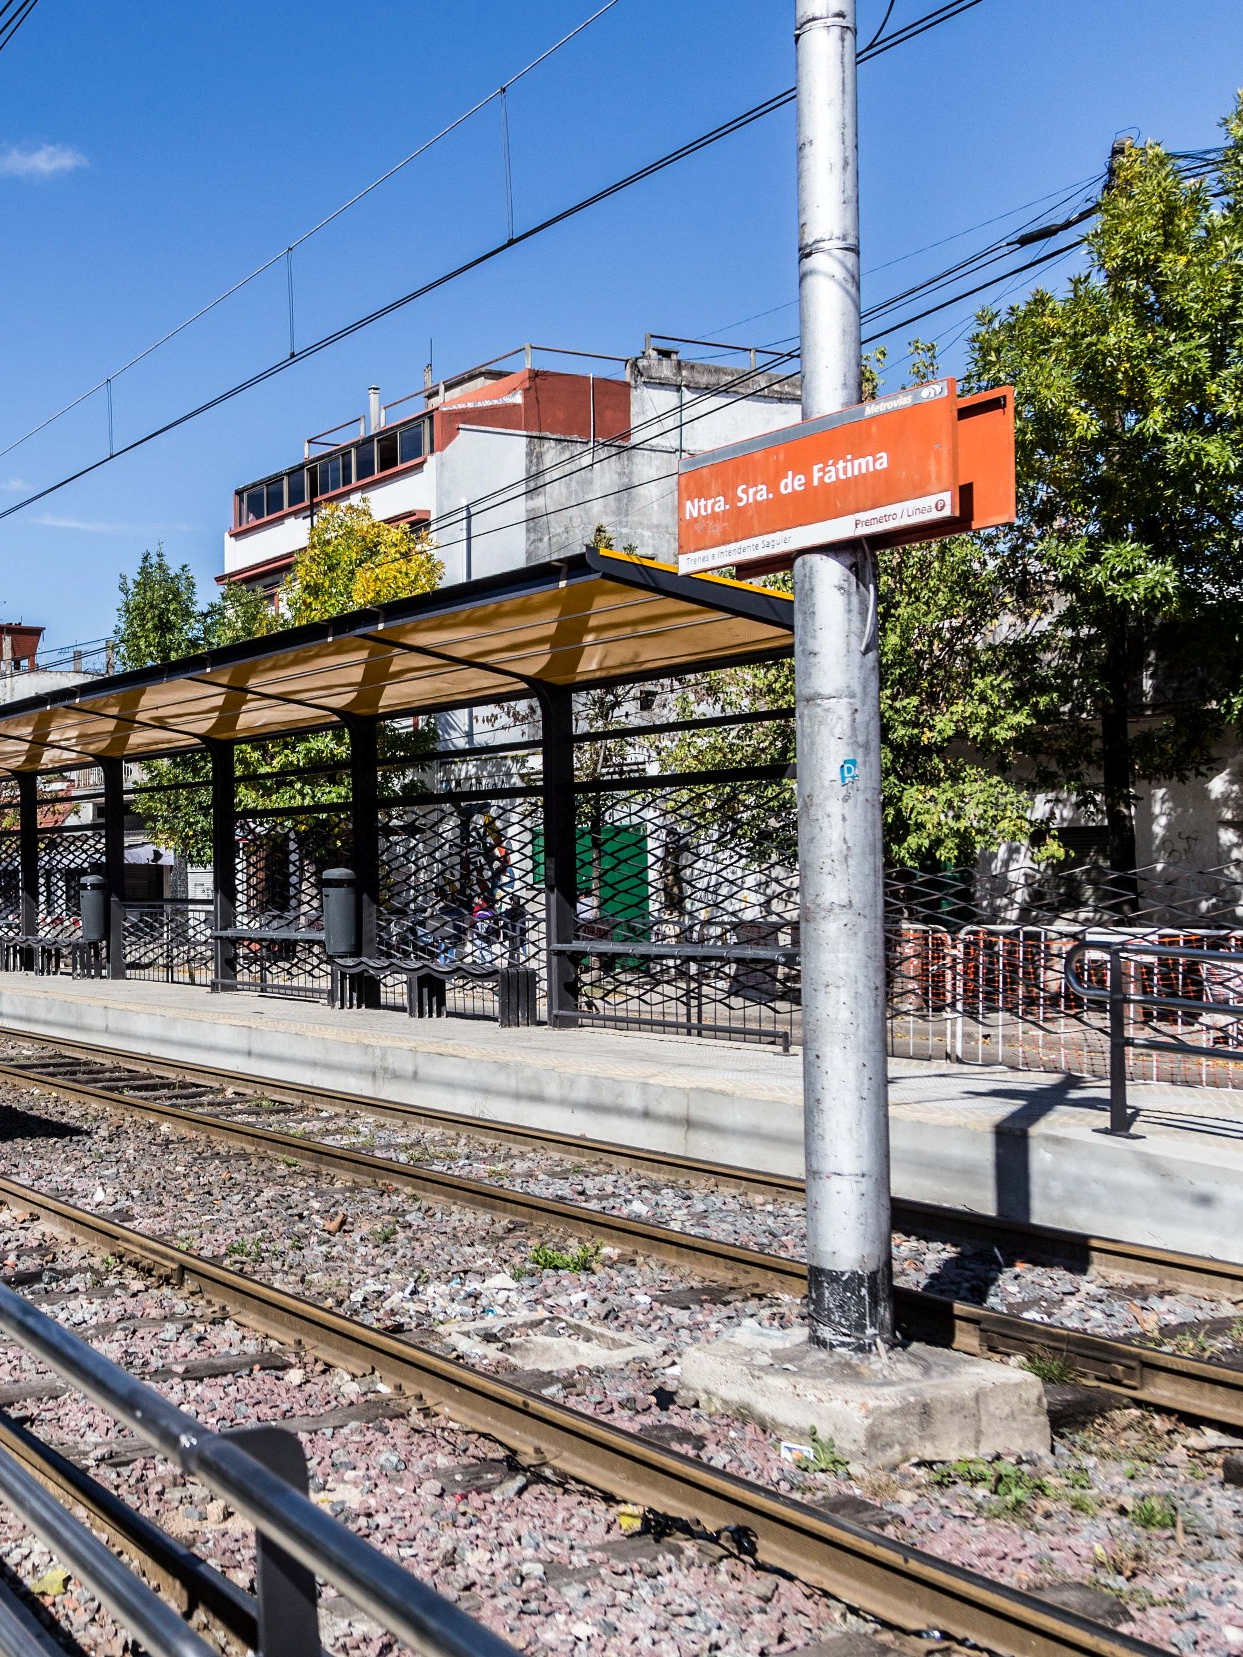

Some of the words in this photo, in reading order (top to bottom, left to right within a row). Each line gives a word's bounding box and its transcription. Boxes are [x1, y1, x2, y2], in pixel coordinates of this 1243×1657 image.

[685, 495, 730, 520] Ntra.
[737, 484, 774, 507] Sra.
[779, 470, 806, 494] de
[812, 451, 888, 486] Fátima
[855, 512, 897, 528] Premetro
[686, 554, 709, 566] Trenes
[717, 543, 759, 559] Intendente
[761, 535, 792, 549] Saguier
